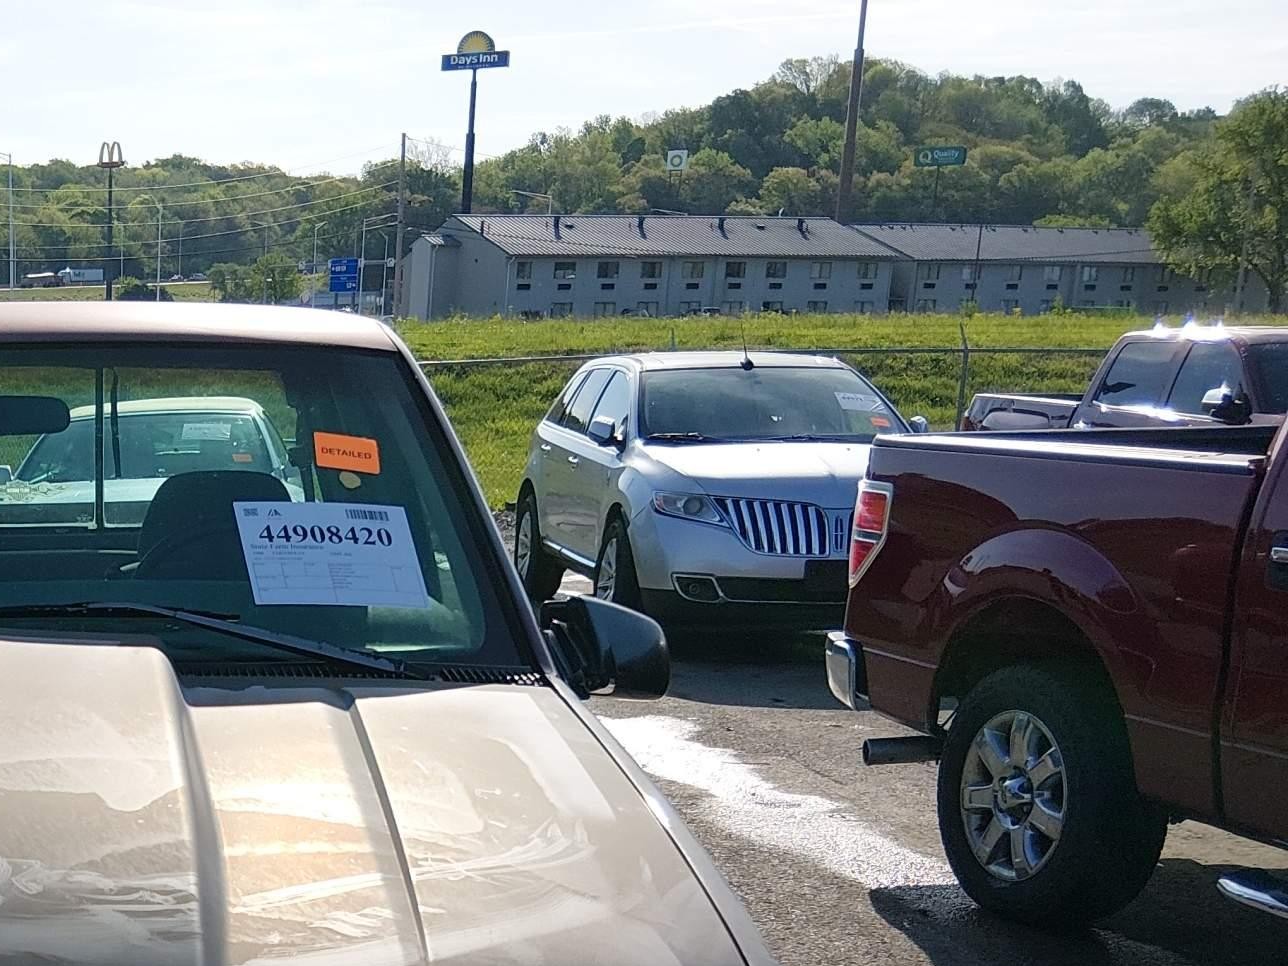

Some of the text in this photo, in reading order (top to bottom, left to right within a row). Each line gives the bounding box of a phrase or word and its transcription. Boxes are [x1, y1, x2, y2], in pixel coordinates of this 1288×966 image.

[450, 54, 498, 65] Days Inn
[933, 150, 960, 161] Quality
[321, 446, 372, 460] DETAILED
[258, 524, 393, 547] 44908420
